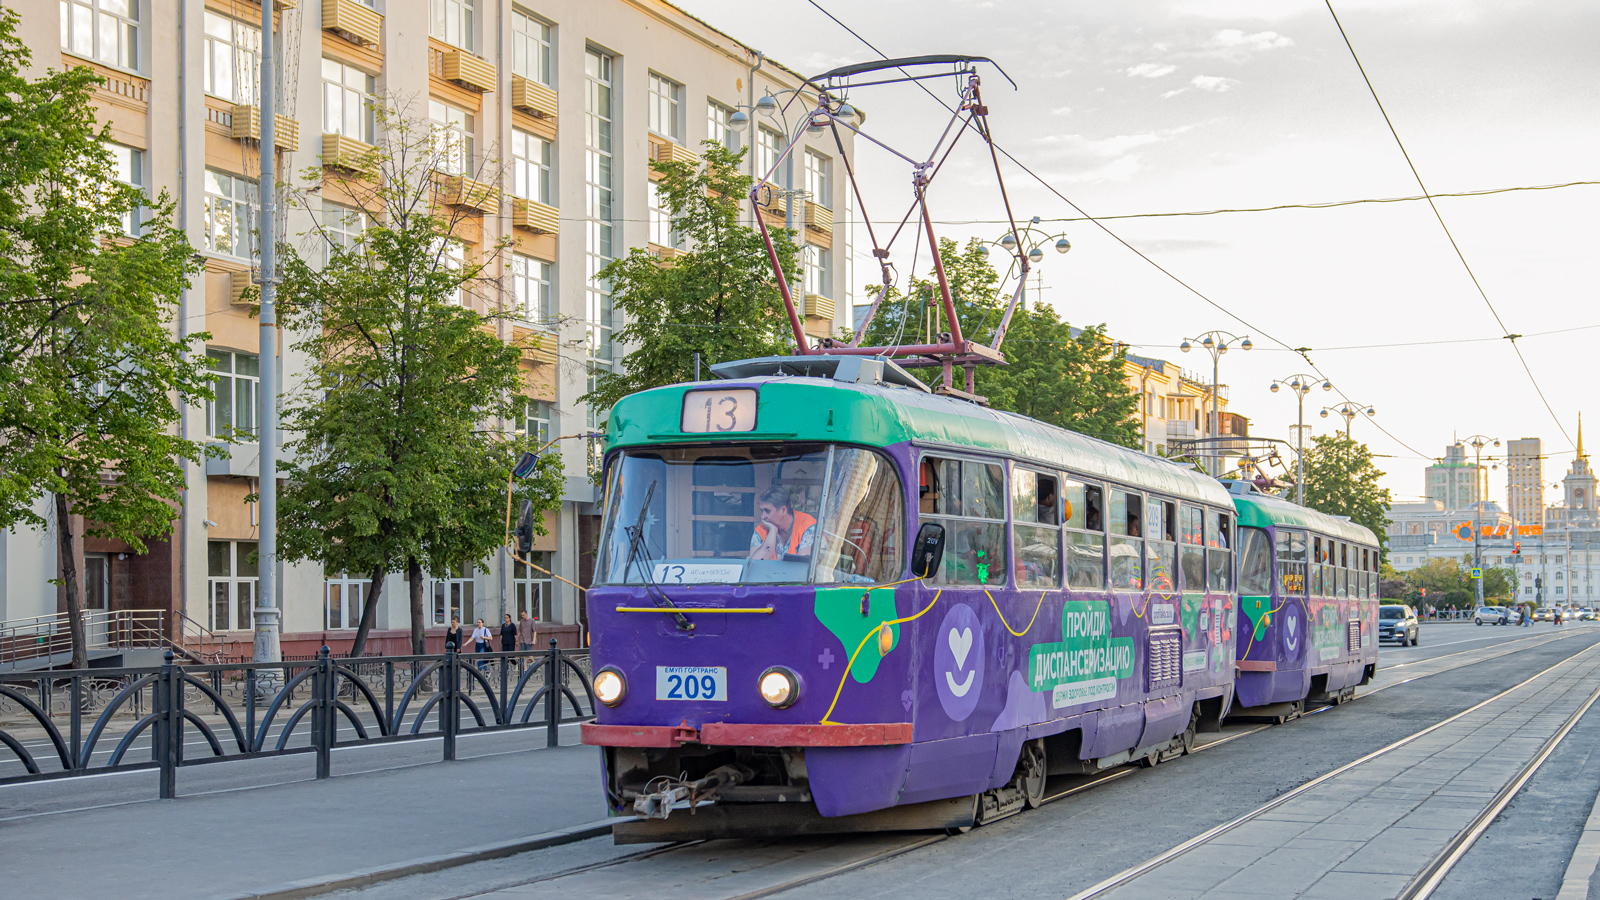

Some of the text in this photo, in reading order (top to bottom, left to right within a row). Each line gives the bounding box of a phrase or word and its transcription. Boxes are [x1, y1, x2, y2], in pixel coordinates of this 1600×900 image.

[705, 397, 738, 432] 13
[926, 537, 938, 545] 209
[1481, 525, 1542, 536] МОТИВ
[662, 565, 686, 583] 13
[1067, 605, 1106, 641] ПРОЙДИ
[1034, 645, 1130, 687] ДИСПАНСЕРИЗАЦИЮ
[667, 674, 716, 699] 209
